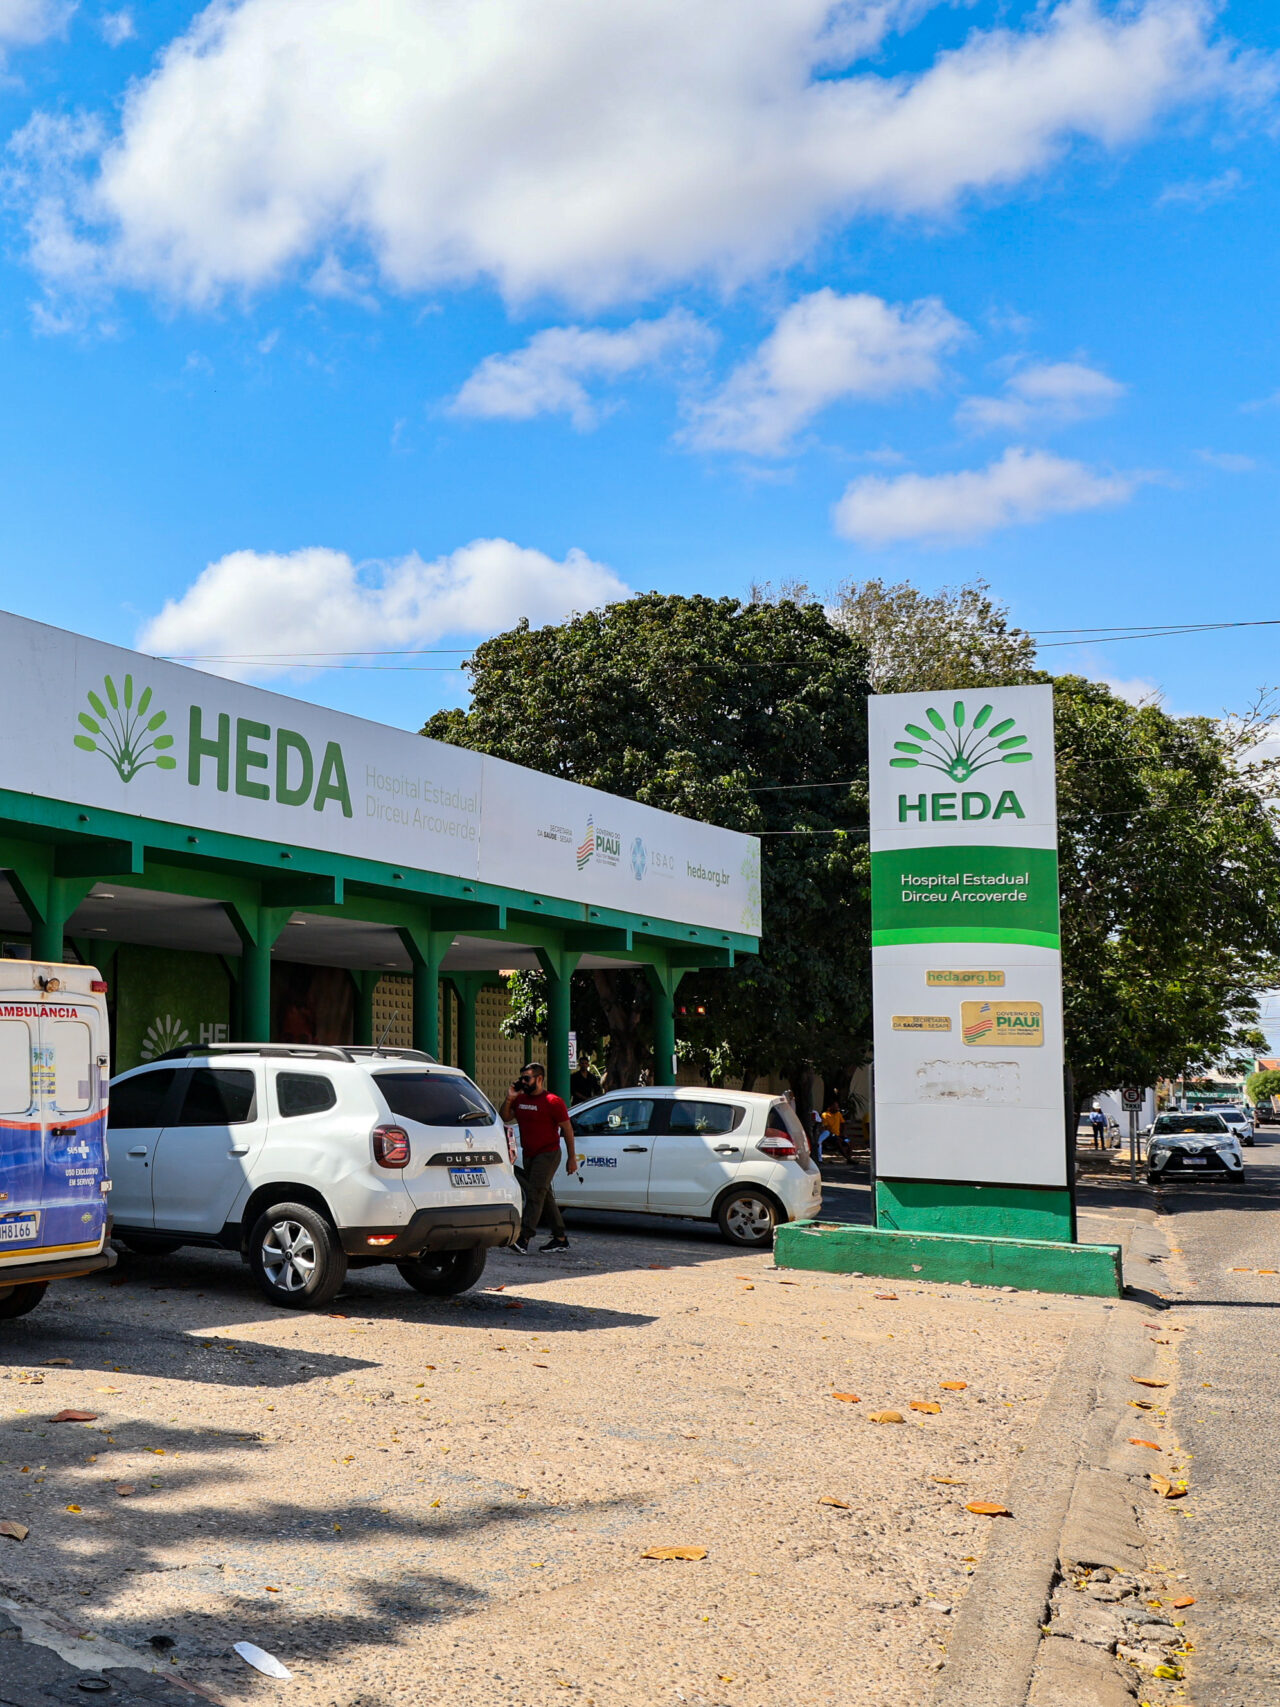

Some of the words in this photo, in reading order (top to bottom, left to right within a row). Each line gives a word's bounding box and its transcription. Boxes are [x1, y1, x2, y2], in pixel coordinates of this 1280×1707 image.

[187, 704, 353, 819] HEDA
[366, 763, 421, 801] Hospital
[424, 780, 478, 815] Estadual
[366, 794, 410, 826] Dirceu
[412, 807, 477, 841] Arcoverde
[898, 790, 1026, 823] HEDA
[686, 860, 731, 888] heda.org.br
[901, 872, 960, 889] Hospital
[963, 872, 1029, 886] Estadual
[901, 890, 948, 903] Dirceu
[950, 889, 1028, 903] Arcoverde
[927, 971, 1003, 985] heda.org.br
[199, 1022, 230, 1045] HE
[66, 1146, 78, 1154] SUS
[446, 1155, 495, 1163] DUSTER
